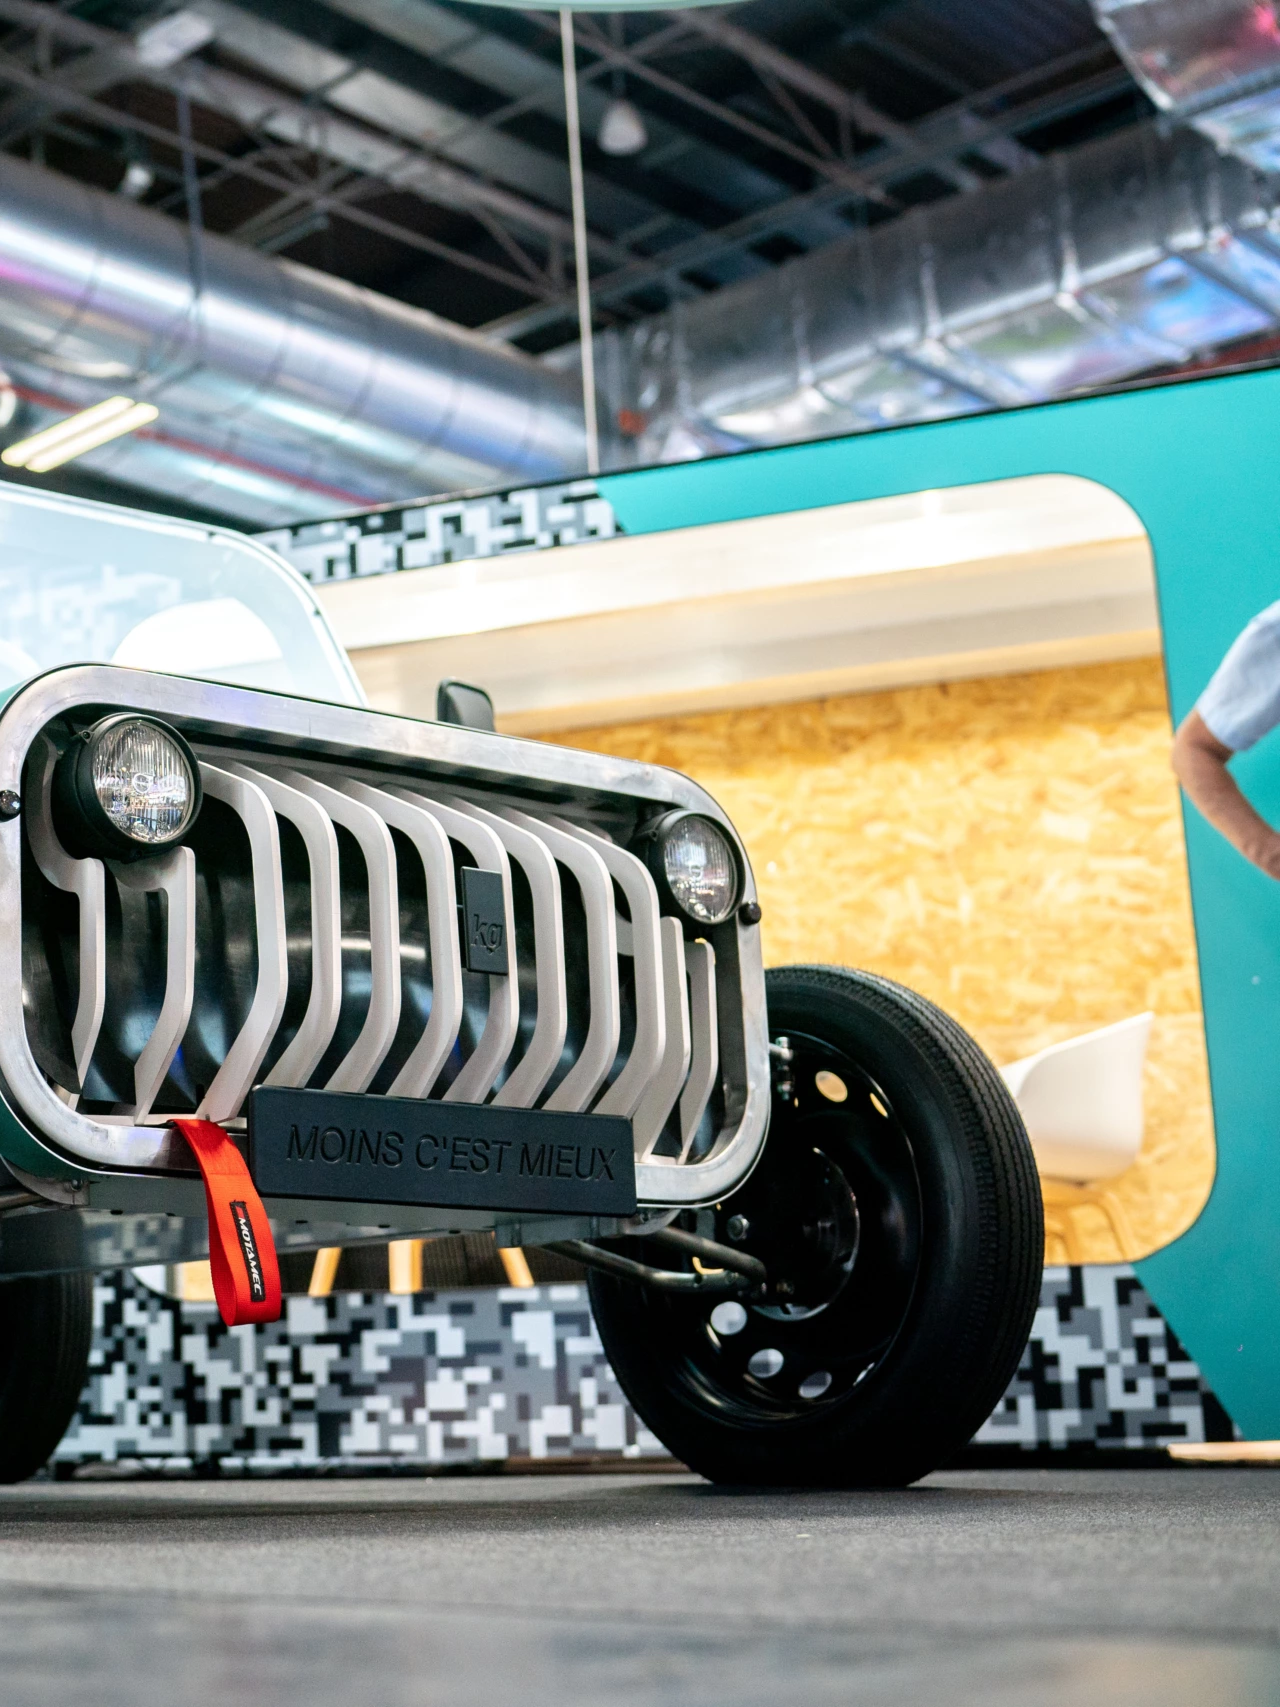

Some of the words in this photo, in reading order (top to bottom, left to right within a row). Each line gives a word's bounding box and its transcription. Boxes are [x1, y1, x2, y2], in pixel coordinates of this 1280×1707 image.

[470, 913, 504, 956] kg
[286, 1123, 404, 1168] MOINS
[415, 1133, 513, 1175] C'EST
[518, 1142, 617, 1182] MIEUX
[238, 1217, 263, 1297] MOTAMEC
